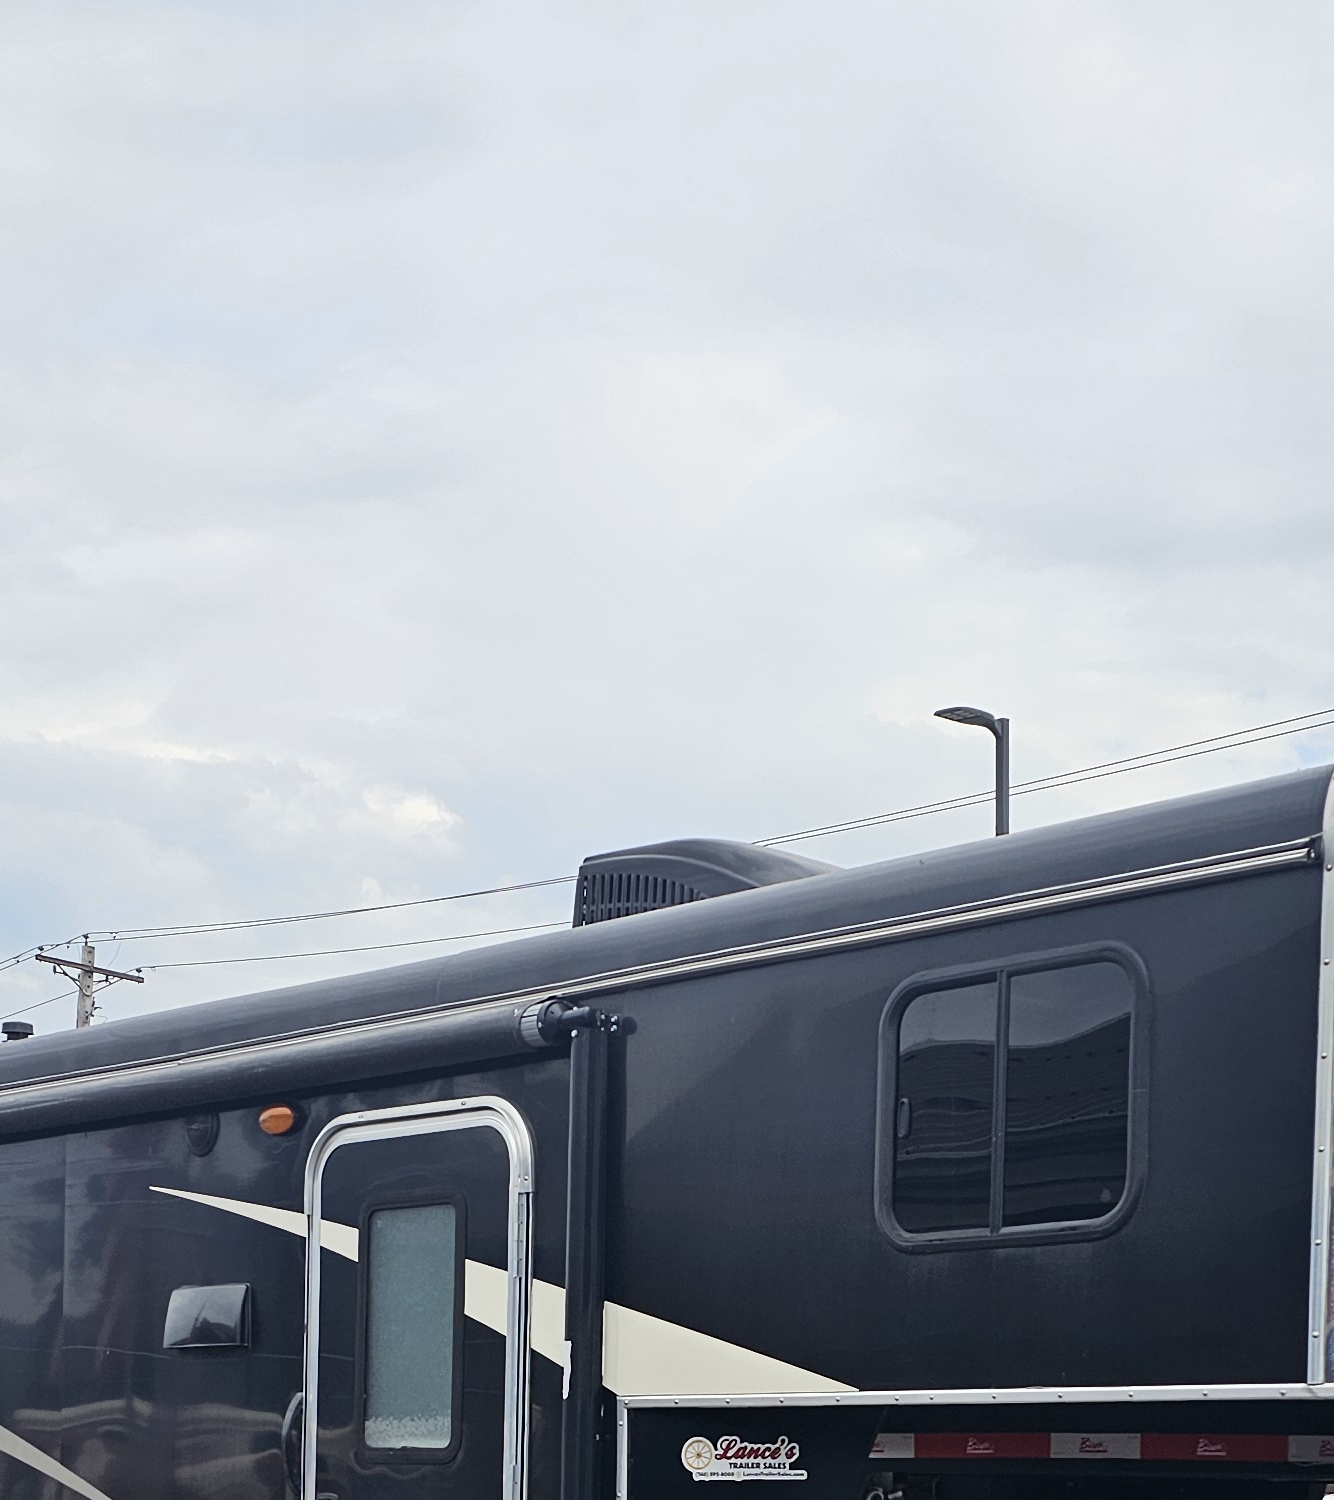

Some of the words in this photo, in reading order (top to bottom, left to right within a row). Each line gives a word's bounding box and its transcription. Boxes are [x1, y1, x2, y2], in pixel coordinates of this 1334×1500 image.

[714, 1438, 797, 1461] Lance's
[728, 1462, 761, 1470] TRAILER
[762, 1462, 787, 1470] SALES
